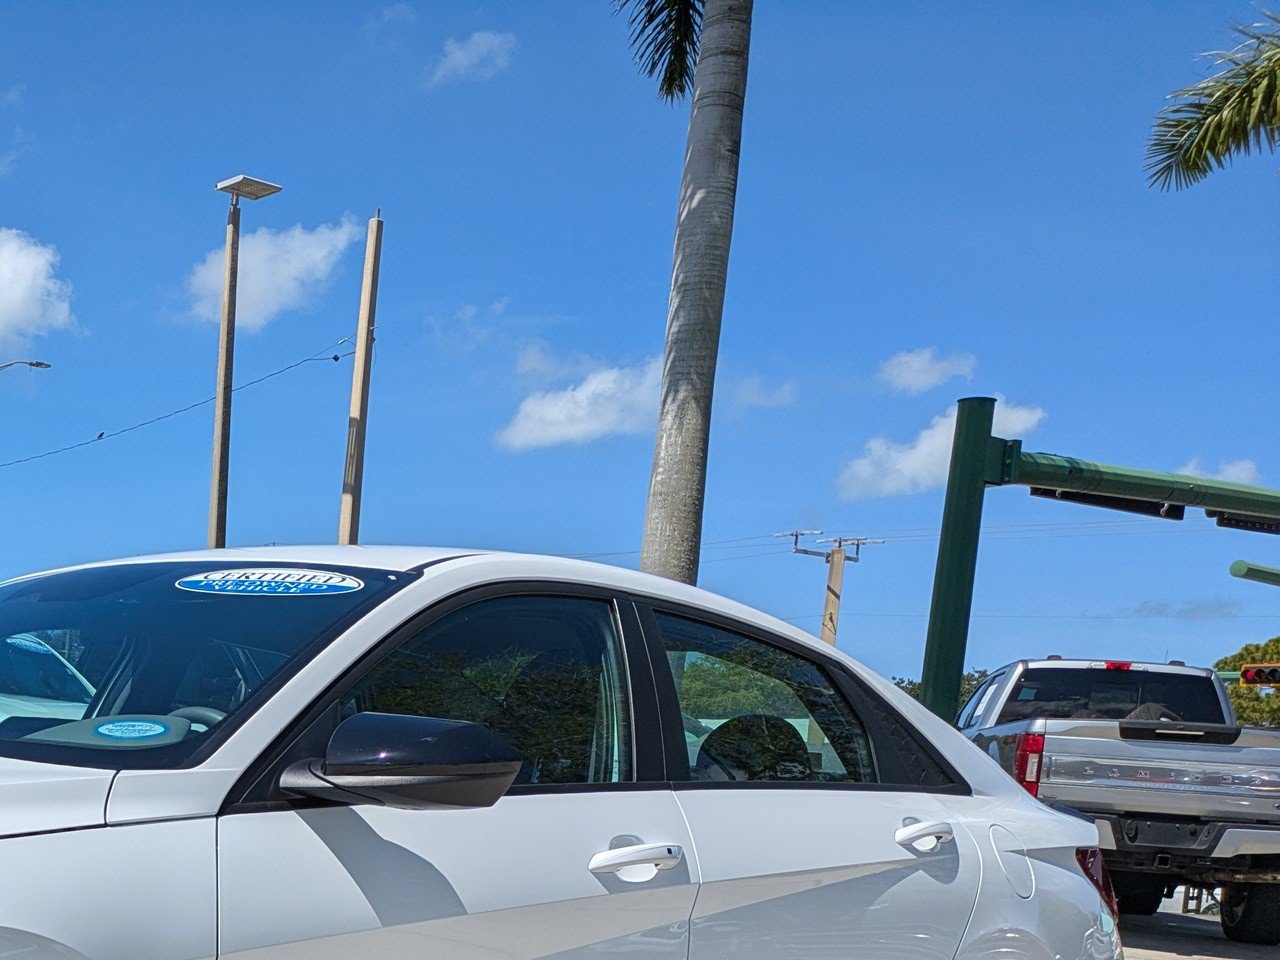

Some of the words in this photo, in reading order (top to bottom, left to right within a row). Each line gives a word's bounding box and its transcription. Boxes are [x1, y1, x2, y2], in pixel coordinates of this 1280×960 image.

[203, 571, 347, 584] CERTIFIED
[199, 580, 328, 590] PRE-OWNED
[213, 584, 302, 593] VEHICLE
